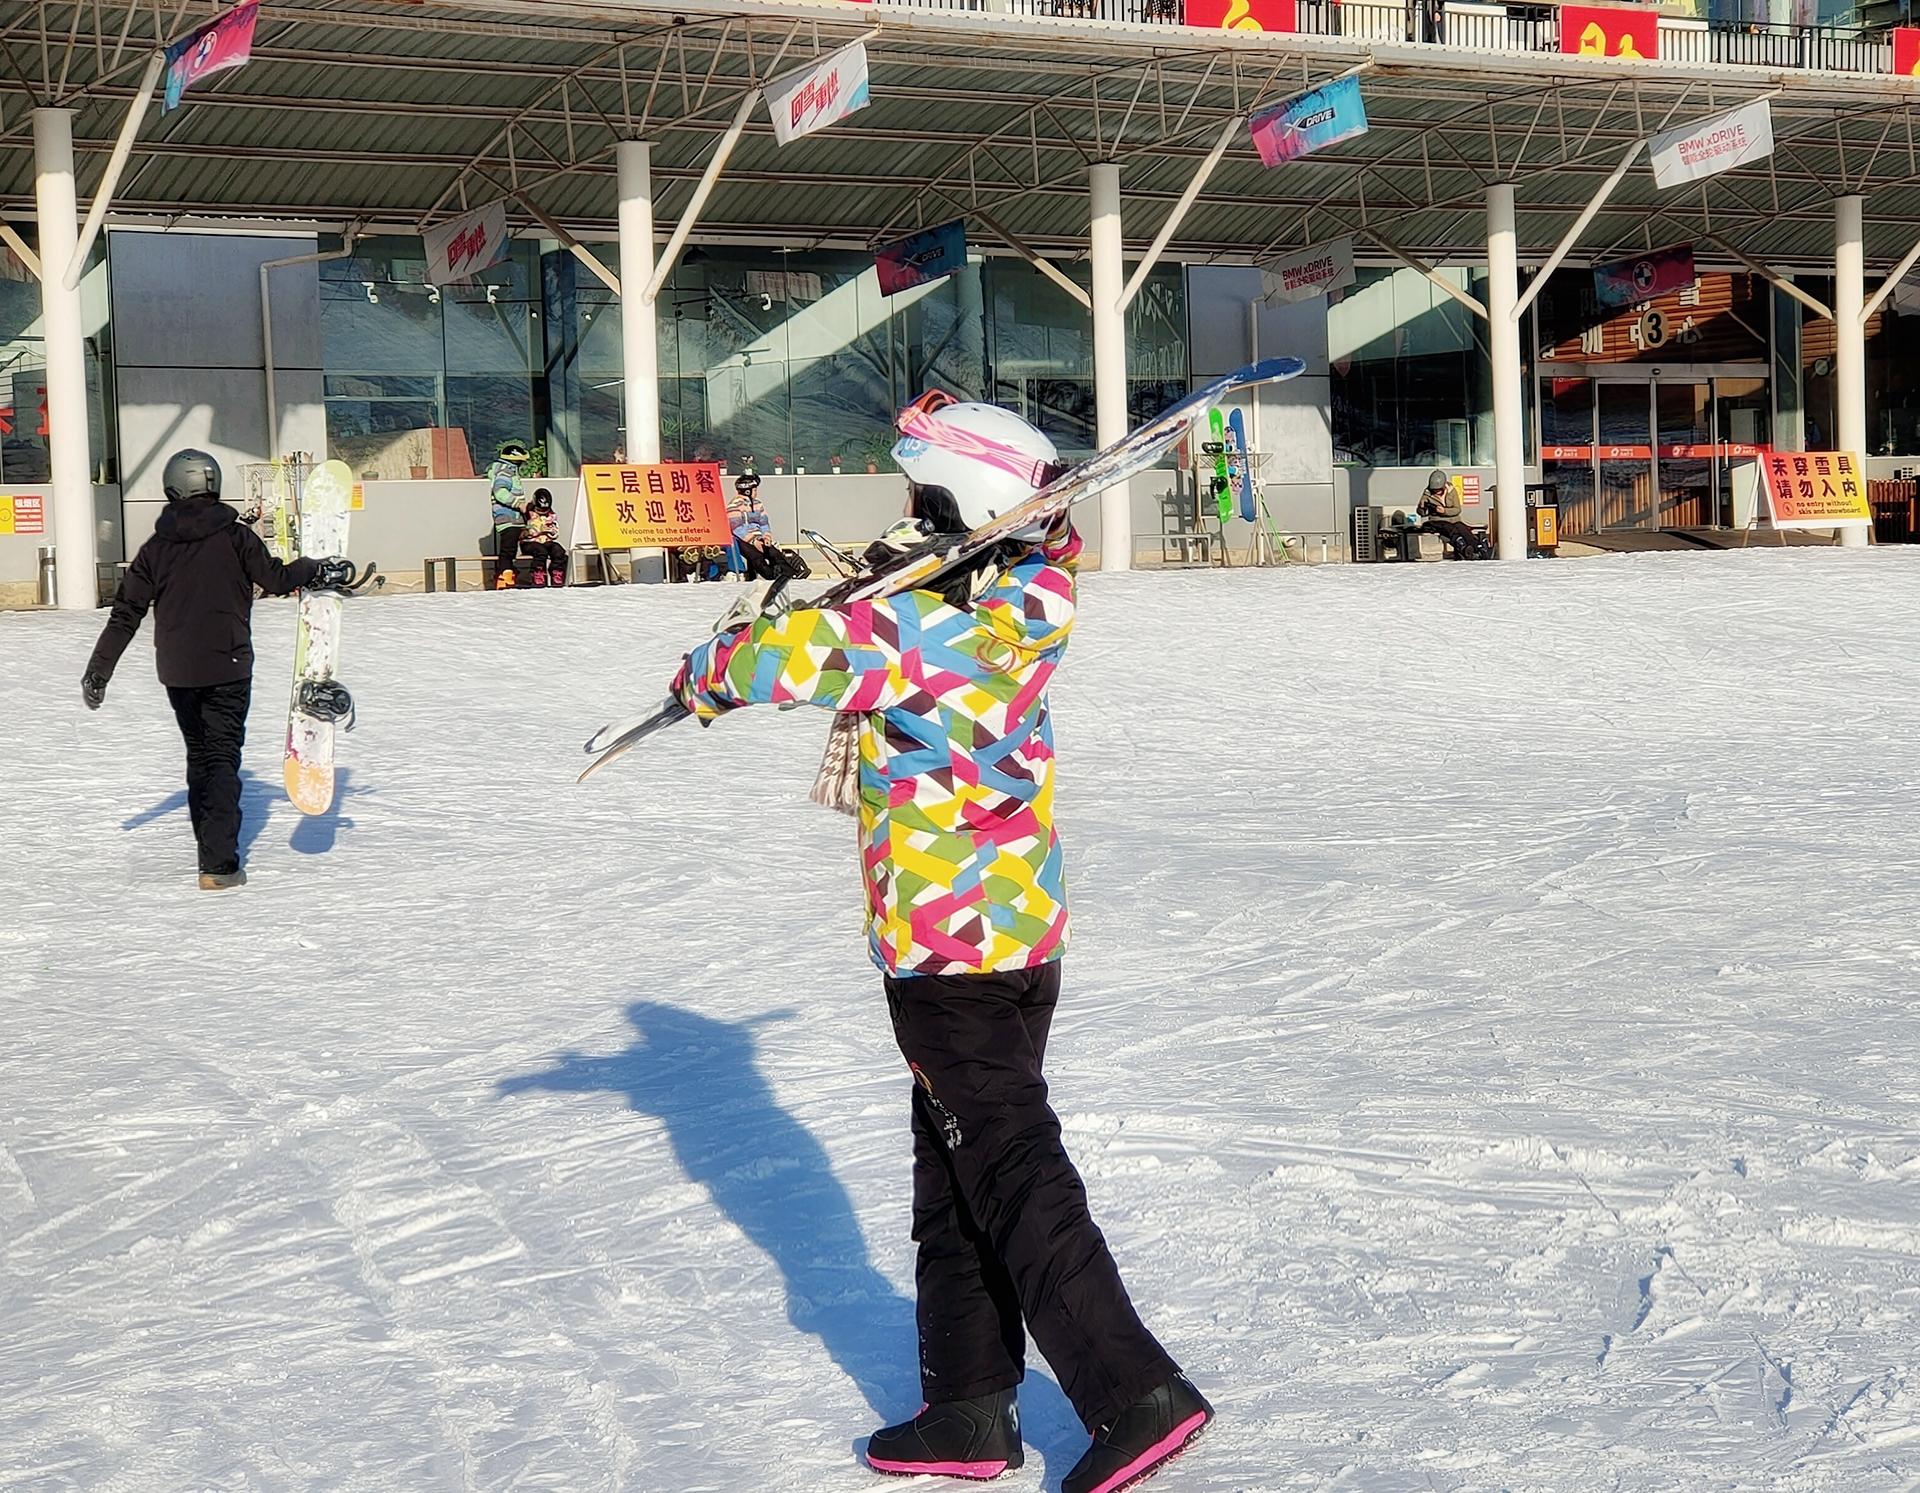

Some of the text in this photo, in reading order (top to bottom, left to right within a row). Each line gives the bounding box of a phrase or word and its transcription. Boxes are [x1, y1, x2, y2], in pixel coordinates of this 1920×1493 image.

[1678, 124, 1744, 154] BMW xDRIVE
[1682, 137, 1747, 166] 智能全轮驱动系统
[1282, 256, 1333, 280] BMW xDRIVE
[1647, 313, 1662, 343] 3
[1772, 456, 1853, 476] 未穿雪具
[595, 469, 715, 494] 二层自助餐
[1776, 478, 1858, 499] 请勿入内
[620, 526, 711, 535] Welcome to the cafeteria
[643, 535, 656, 543] the
[657, 535, 683, 543] second
